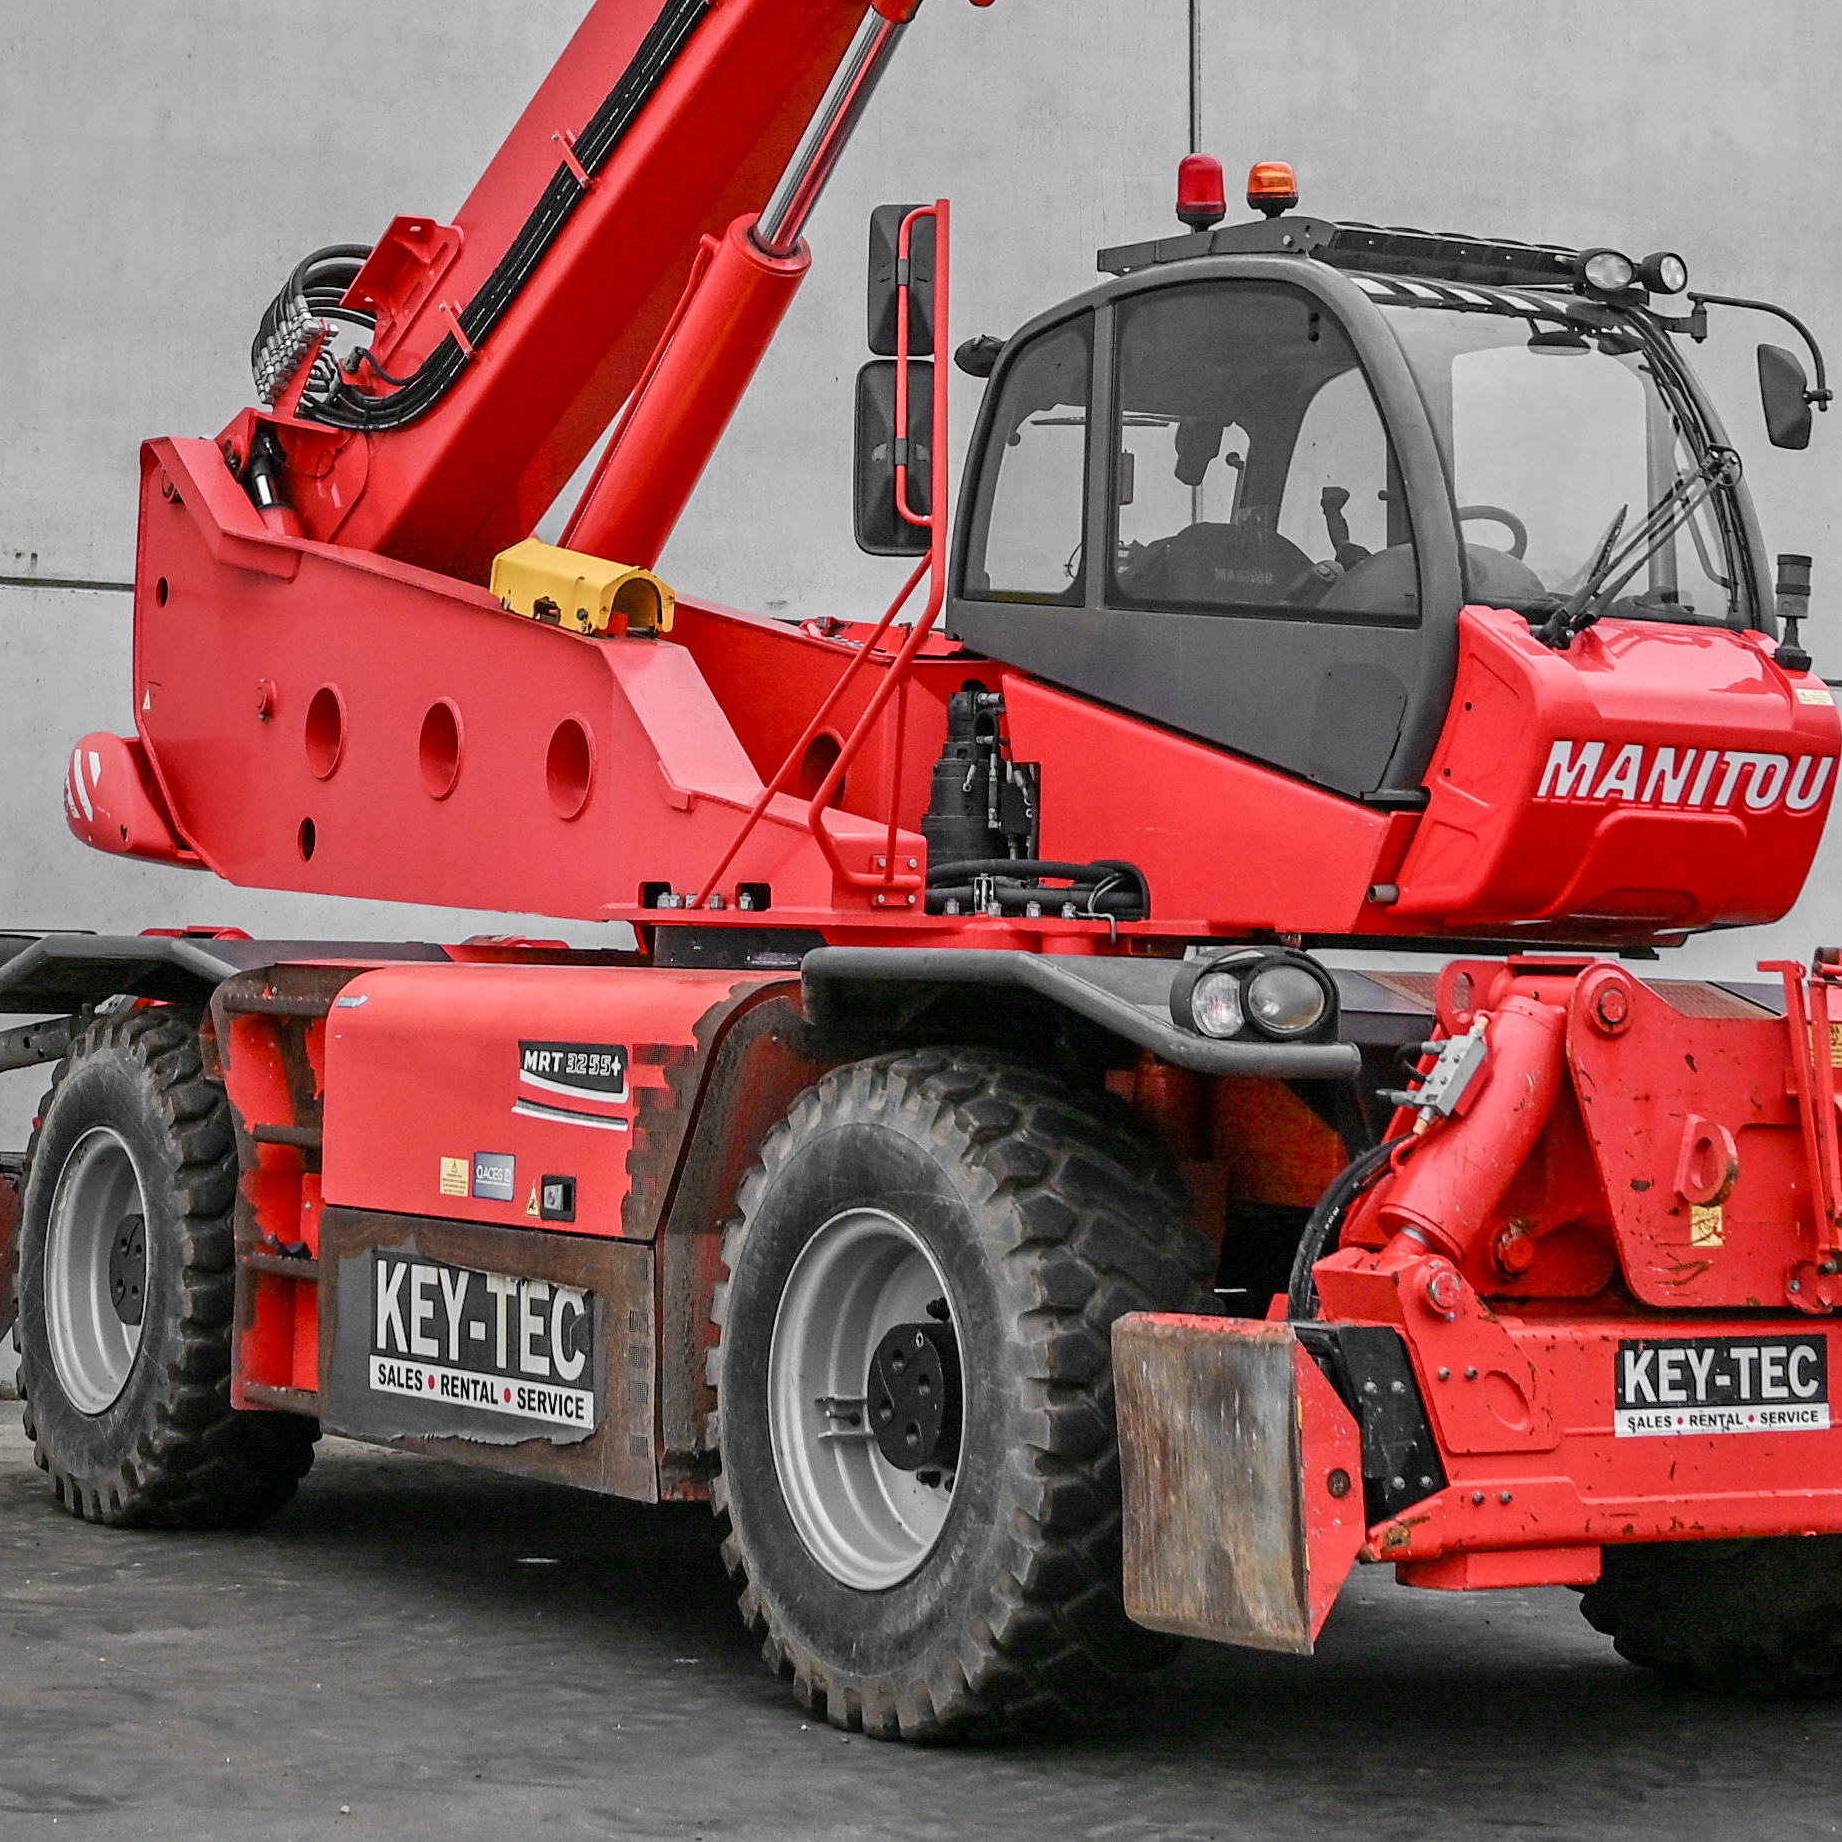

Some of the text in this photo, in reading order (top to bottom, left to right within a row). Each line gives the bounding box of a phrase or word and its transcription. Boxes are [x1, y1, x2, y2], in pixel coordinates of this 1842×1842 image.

[1536, 740, 1834, 811] MANITOU
[523, 1049, 564, 1073] MRT
[376, 1259, 587, 1382] KEY-TEC
[378, 1363, 585, 1420] SALES RENTAL SERVICE
[1623, 1344, 1820, 1404] KEY-TEC
[1627, 1410, 1819, 1430] SALES RENTAL SERVICE
